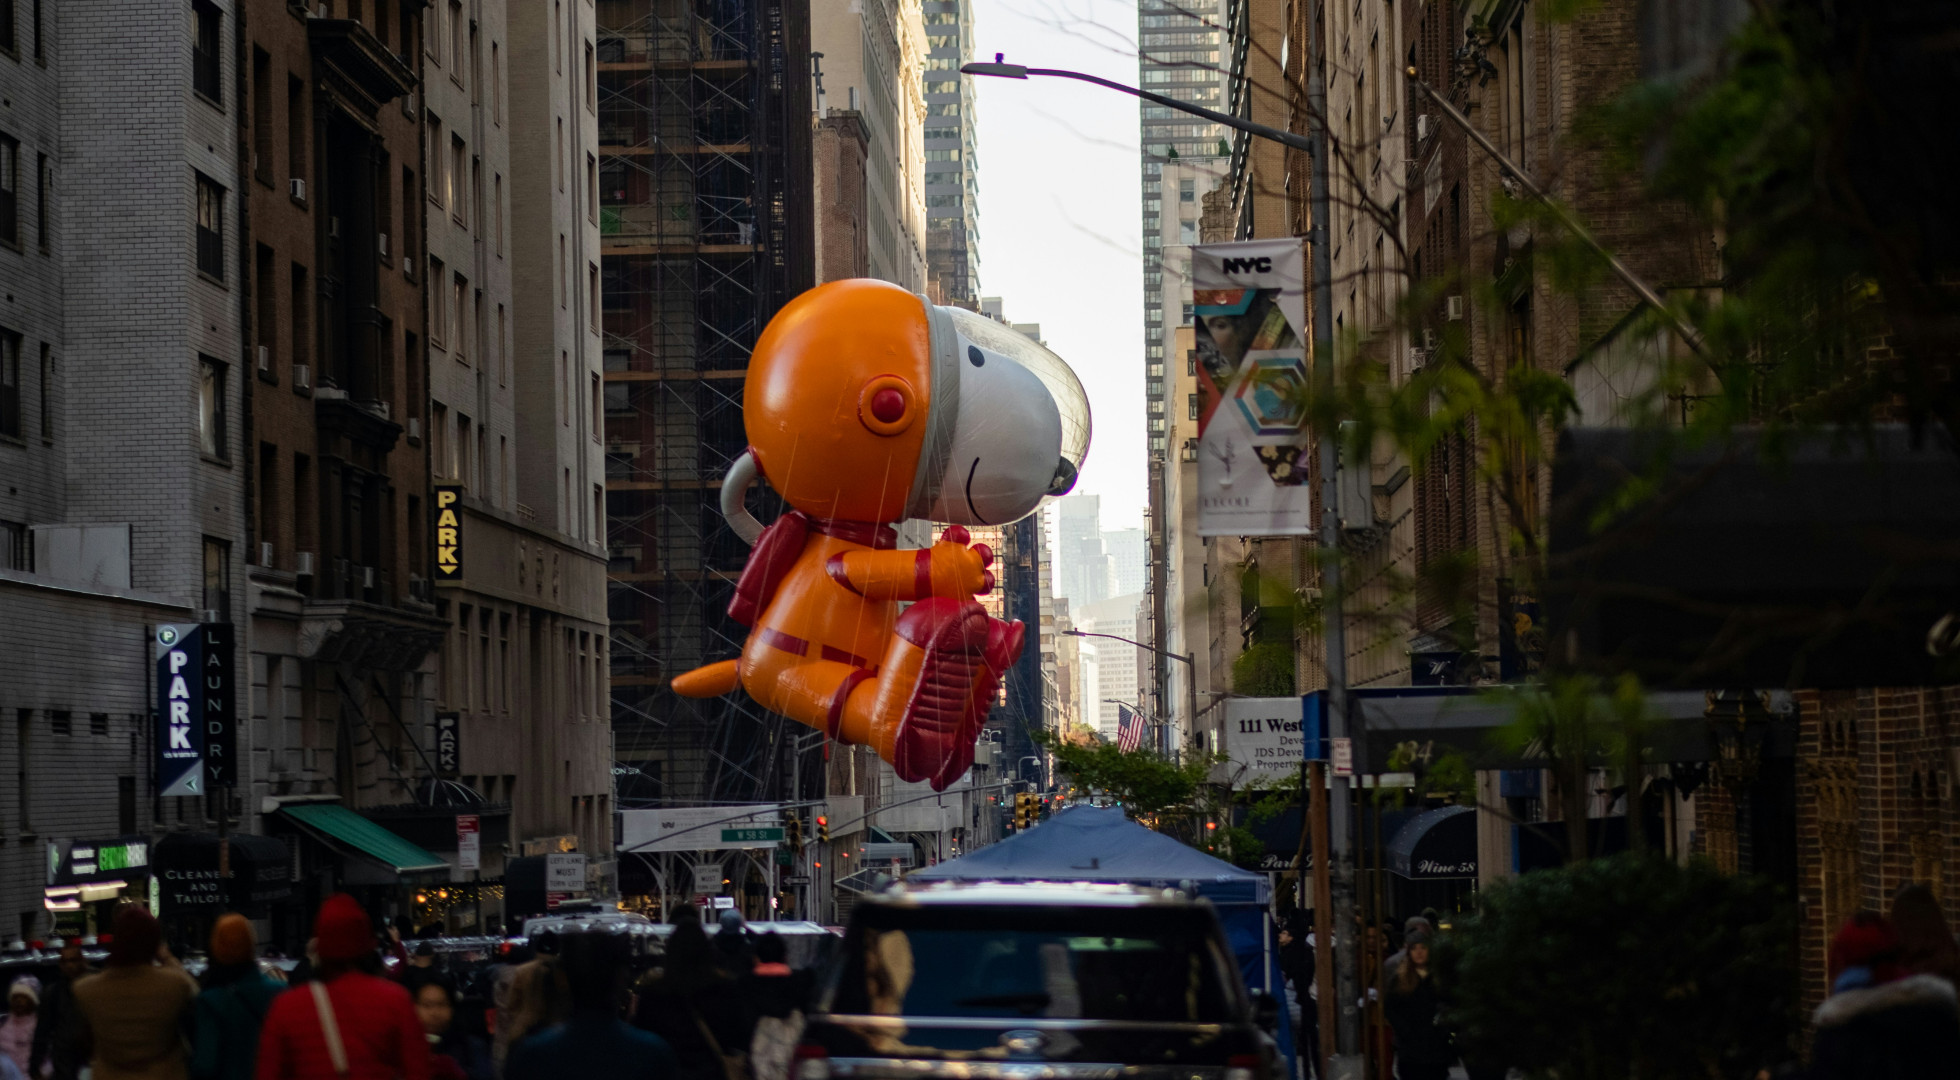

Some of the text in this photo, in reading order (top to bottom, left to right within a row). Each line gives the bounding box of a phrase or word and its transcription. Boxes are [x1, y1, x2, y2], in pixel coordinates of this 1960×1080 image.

[1222, 257, 1272, 274] NYC
[437, 490, 459, 564] PARK
[168, 650, 192, 749] PARK
[207, 631, 223, 780] LAUNDRY
[1239, 718, 1304, 733] 111 West
[439, 718, 456, 765] PARK
[1254, 747, 1303, 757] JDS Deve
[1256, 760, 1298, 771] Property
[737, 830, 767, 840] W 58 St
[556, 868, 576, 876] MUST
[1417, 859, 1476, 873] Wine 58
[164, 869, 236, 880] CLEANES
[189, 882, 218, 892] AND
